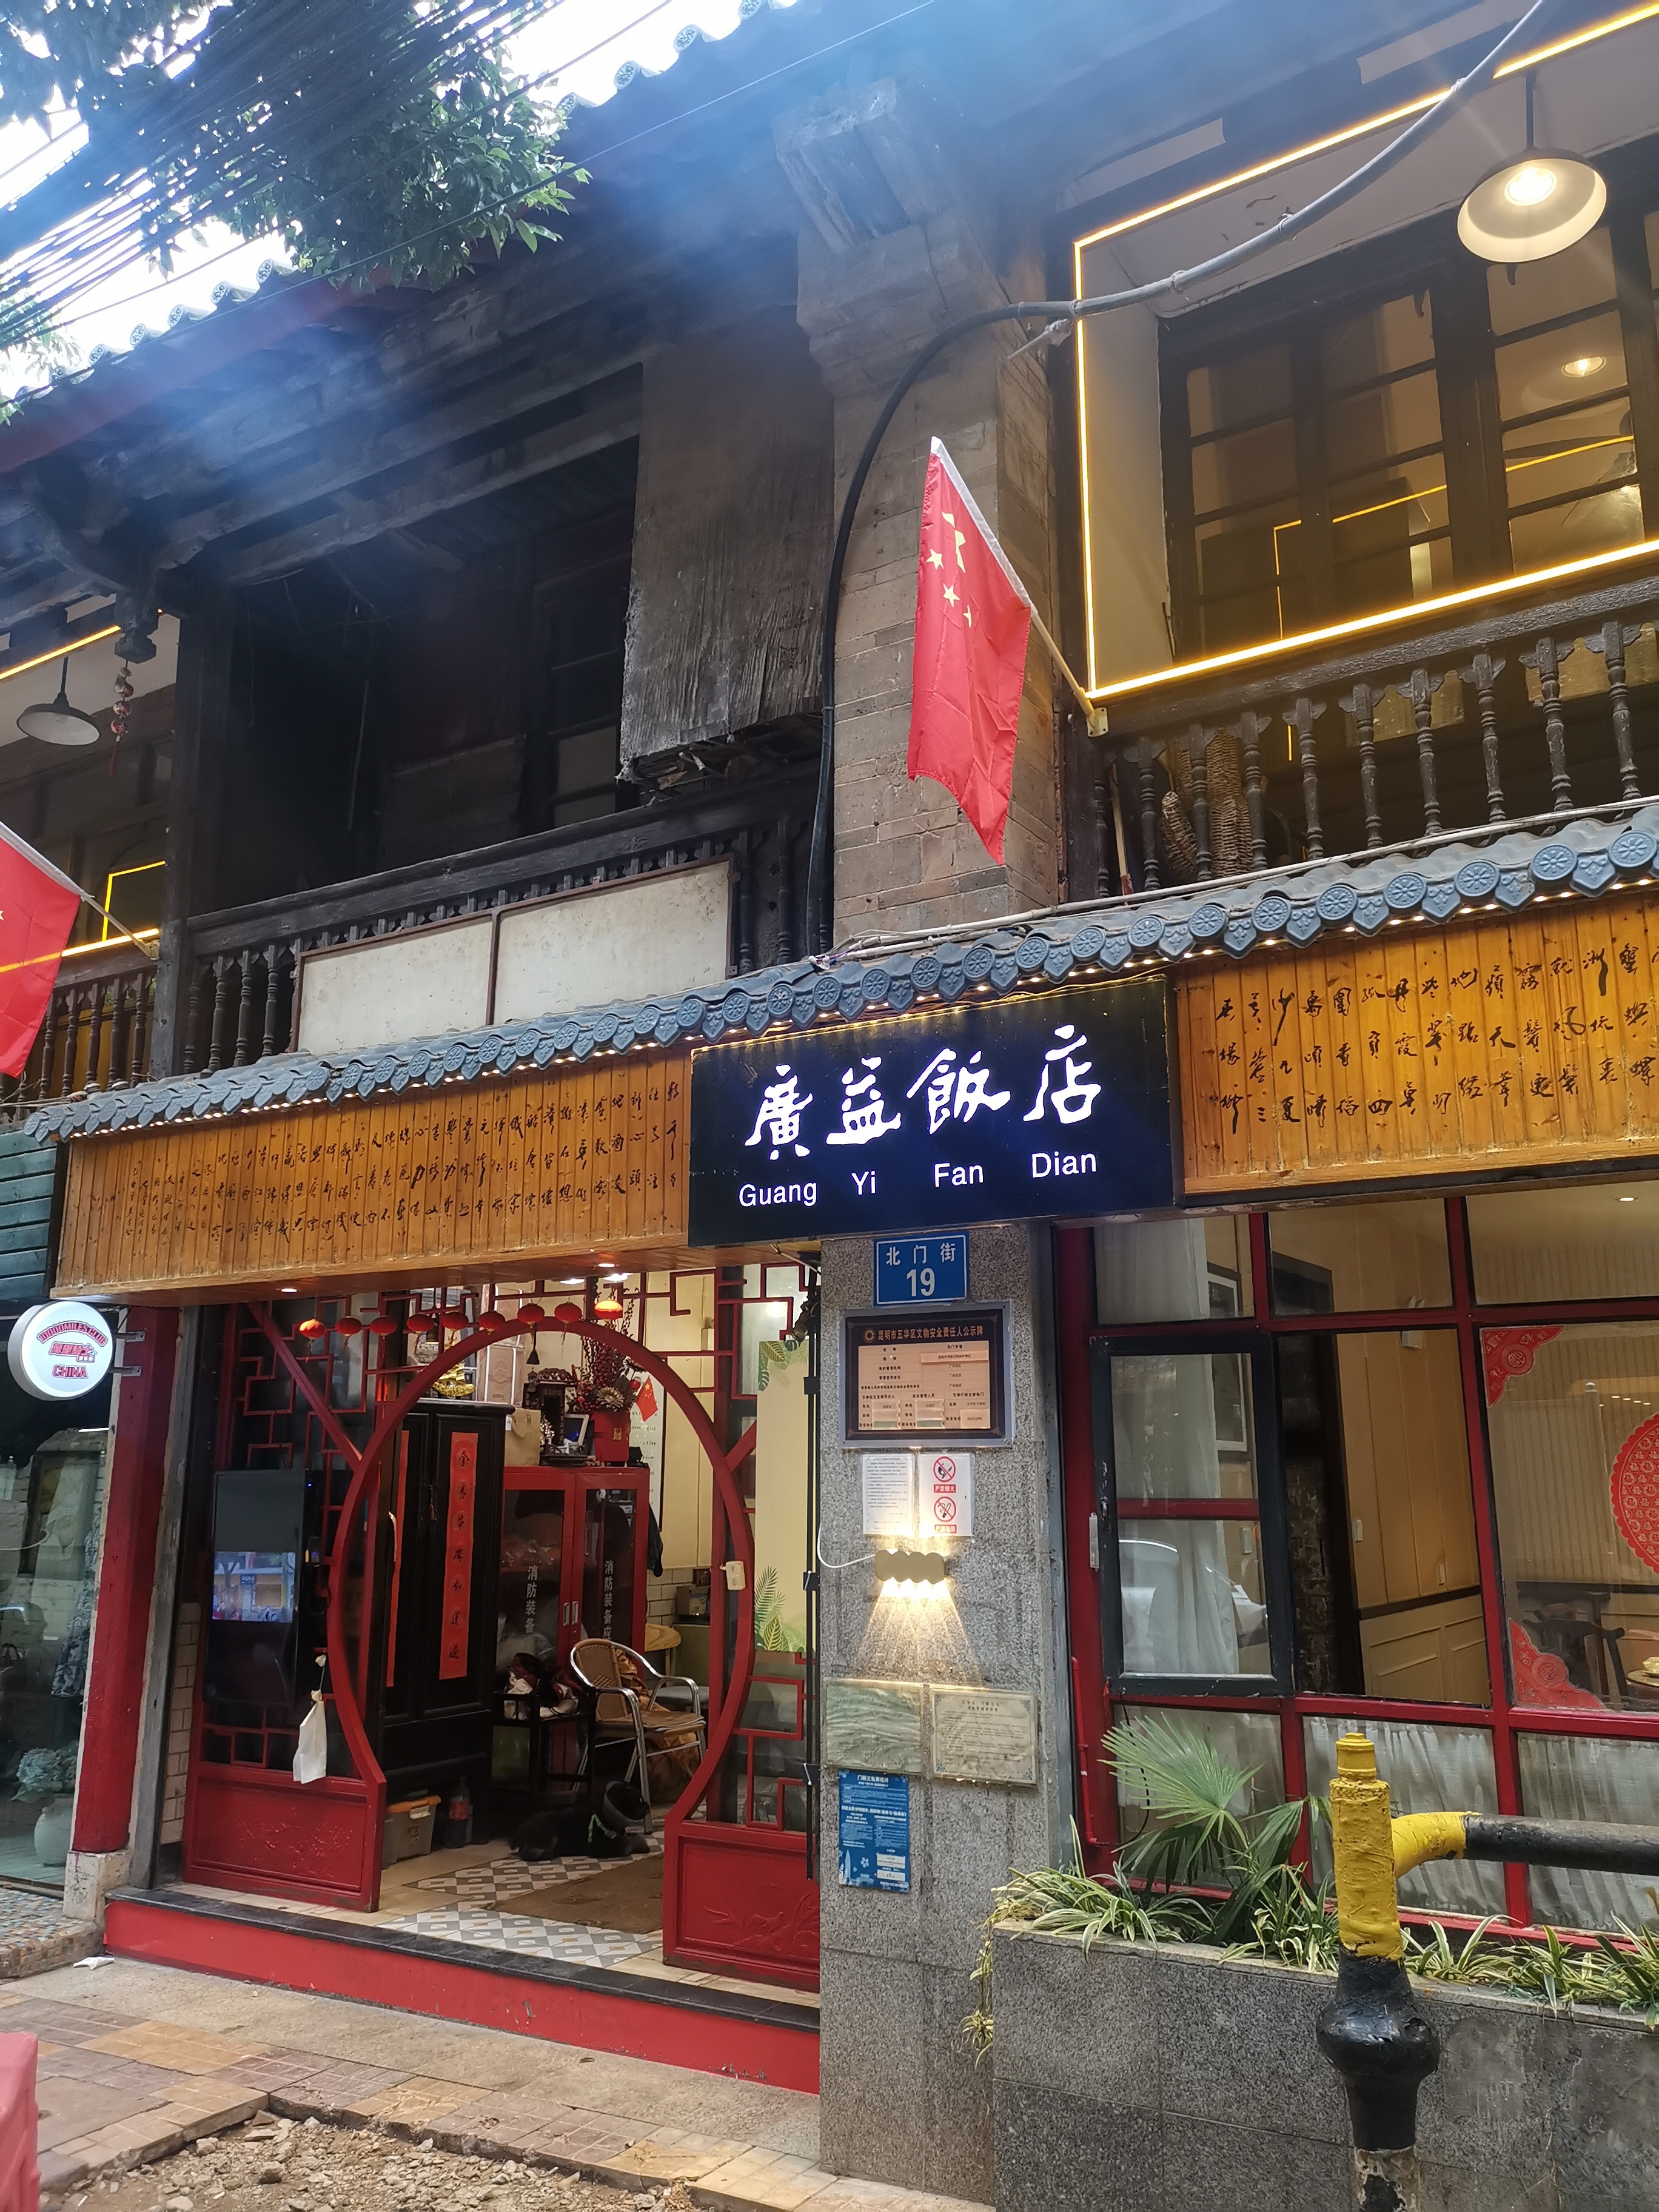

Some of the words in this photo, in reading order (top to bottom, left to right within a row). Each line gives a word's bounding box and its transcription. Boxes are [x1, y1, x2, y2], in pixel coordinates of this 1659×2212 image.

[745, 1024, 1102, 1161] 廣益飯店
[739, 1178, 817, 1207] Guang
[851, 1170, 876, 1195] Yi
[934, 1161, 984, 1188] Fan
[1031, 1150, 1096, 1178] Dian
[886, 1242, 956, 1266] 北门街
[907, 1268, 935, 1297] 19
[53, 1365, 87, 1377] CHINA
[525, 1565, 538, 1634] 消防装备
